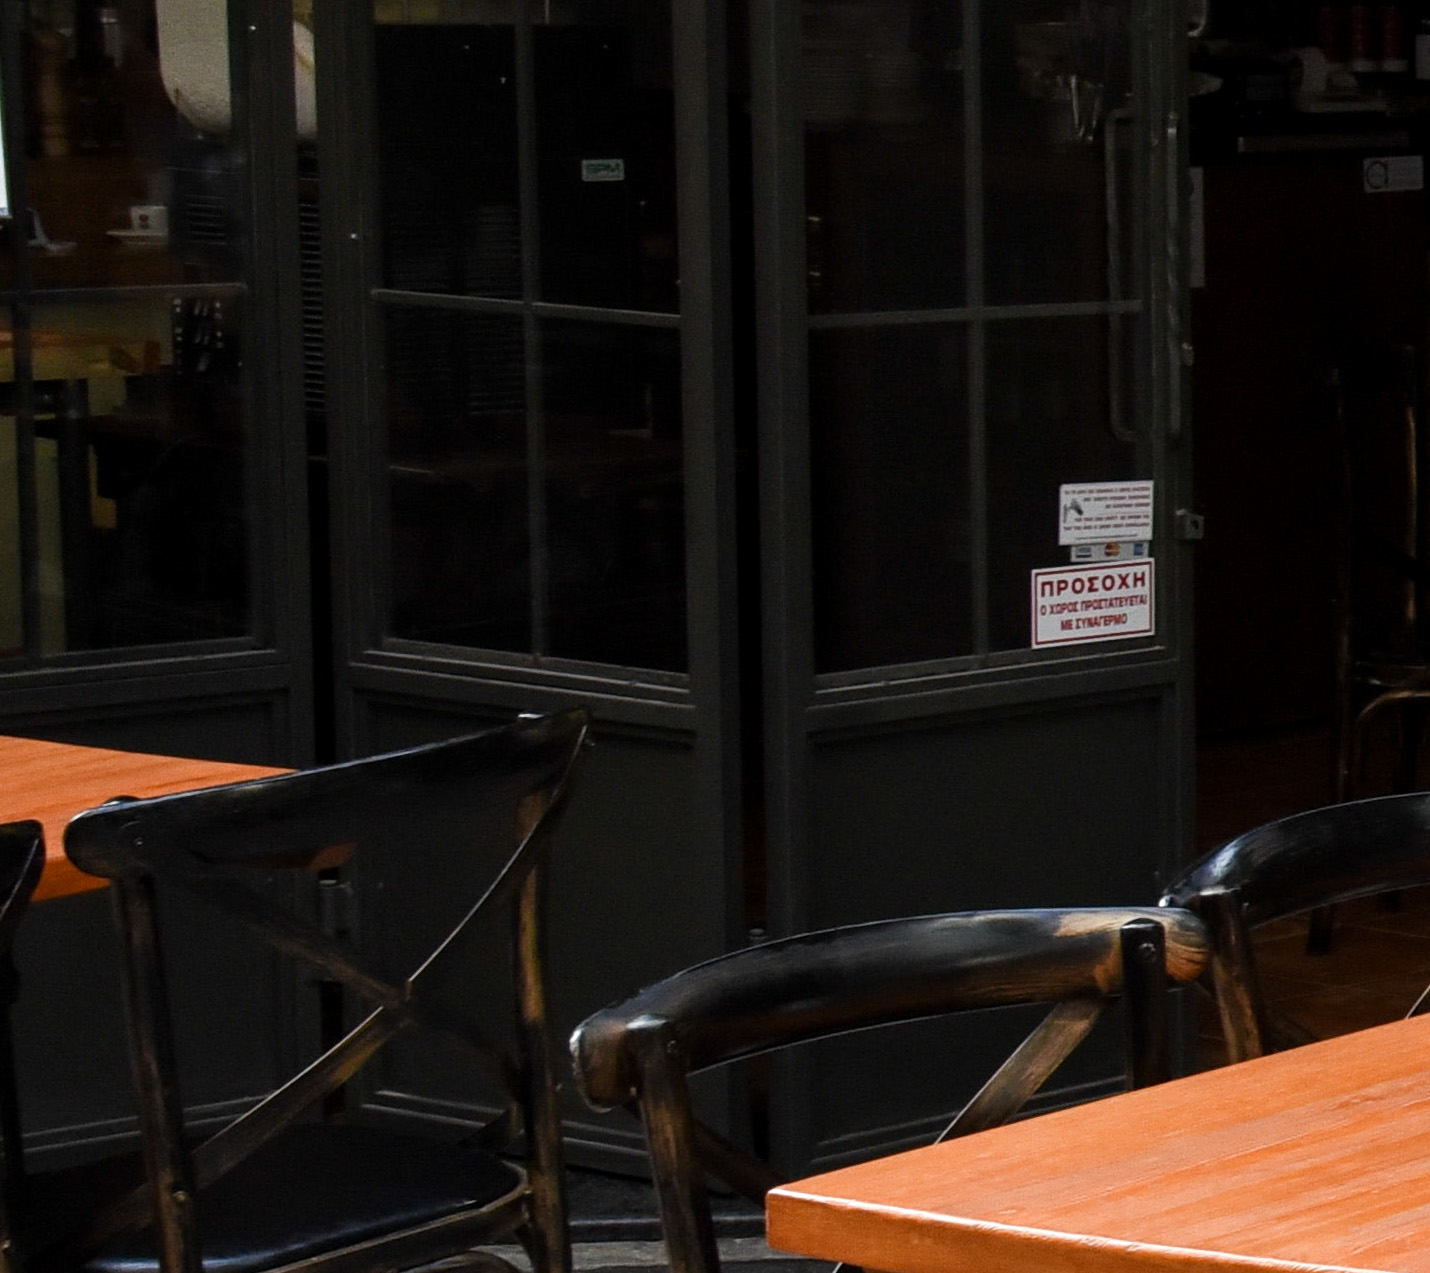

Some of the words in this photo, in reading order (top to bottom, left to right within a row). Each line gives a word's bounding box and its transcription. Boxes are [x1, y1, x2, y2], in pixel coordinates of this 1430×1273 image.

[1041, 571, 1146, 598] ΠΡΟΣΟΧΗ
[1040, 605, 1047, 616] Ο
[1060, 619, 1073, 631] ΜΕ
